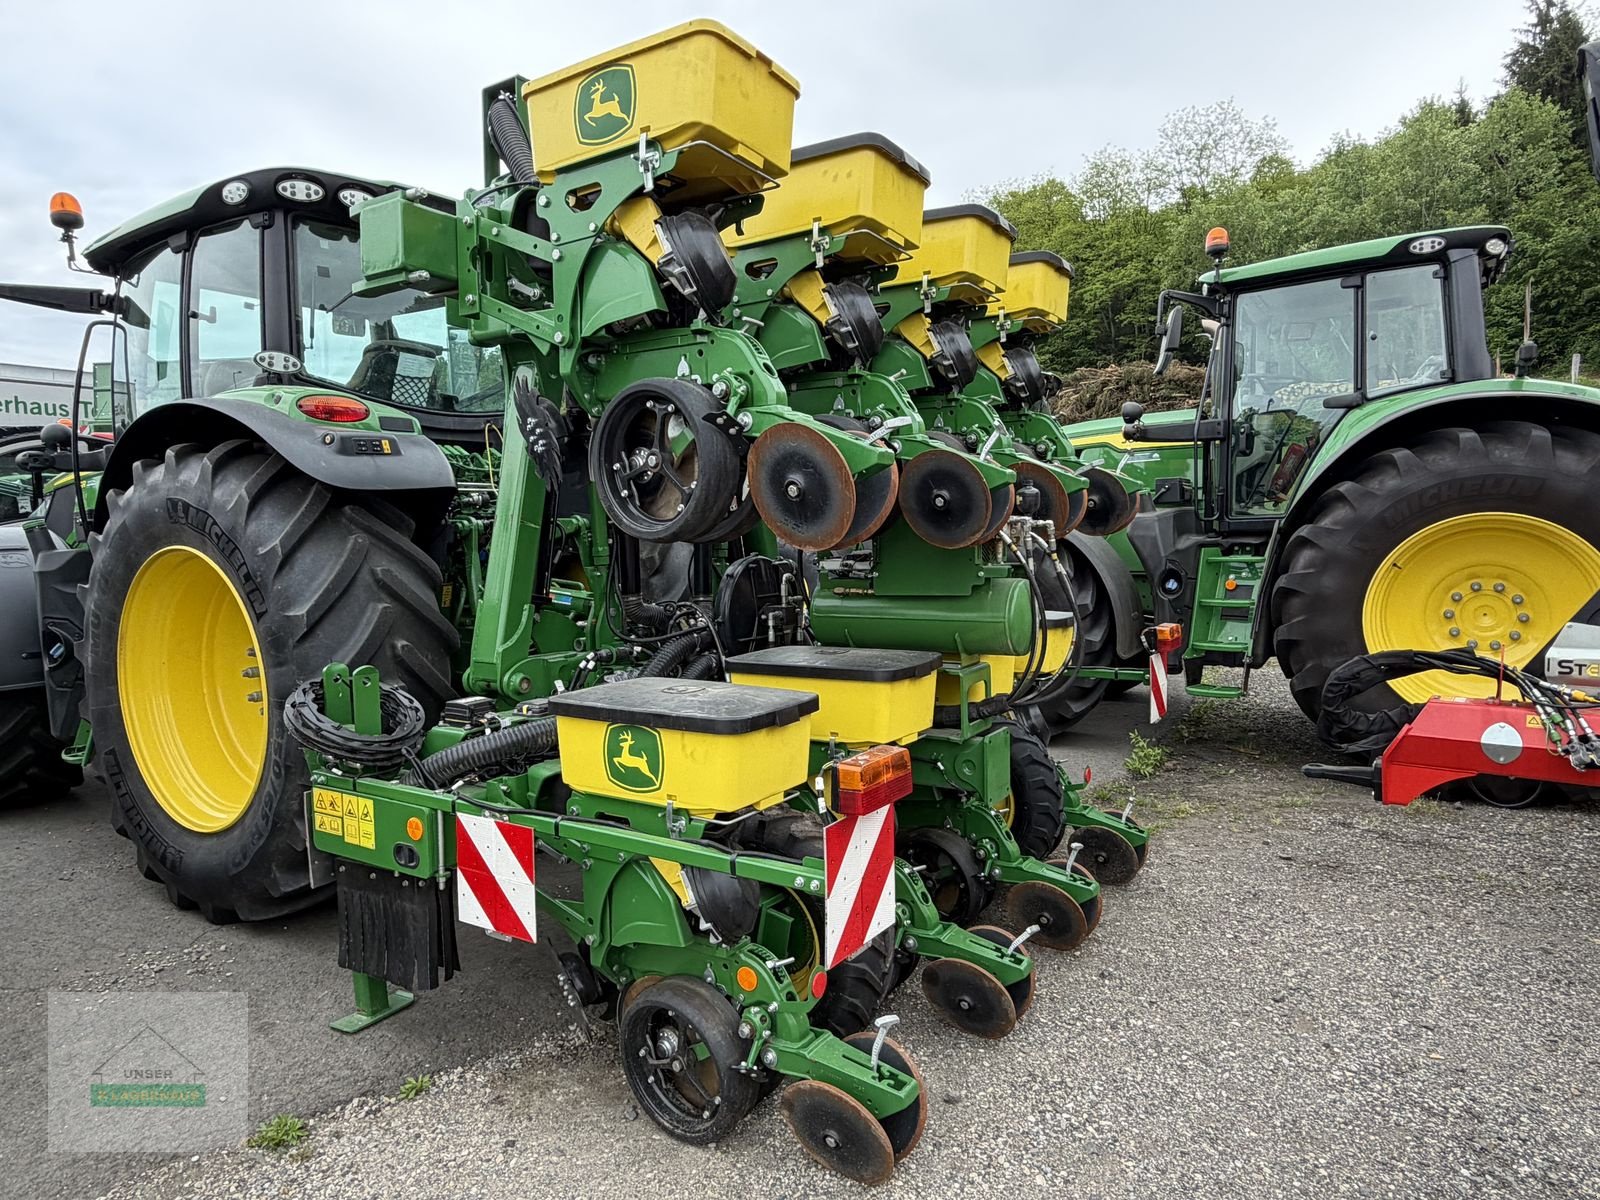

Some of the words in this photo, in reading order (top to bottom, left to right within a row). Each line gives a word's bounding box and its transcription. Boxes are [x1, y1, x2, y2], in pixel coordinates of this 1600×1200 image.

[1387, 476, 1544, 526] MICHELIN
[187, 504, 268, 618] MICHELIN
[104, 750, 167, 864] MICHELIN
